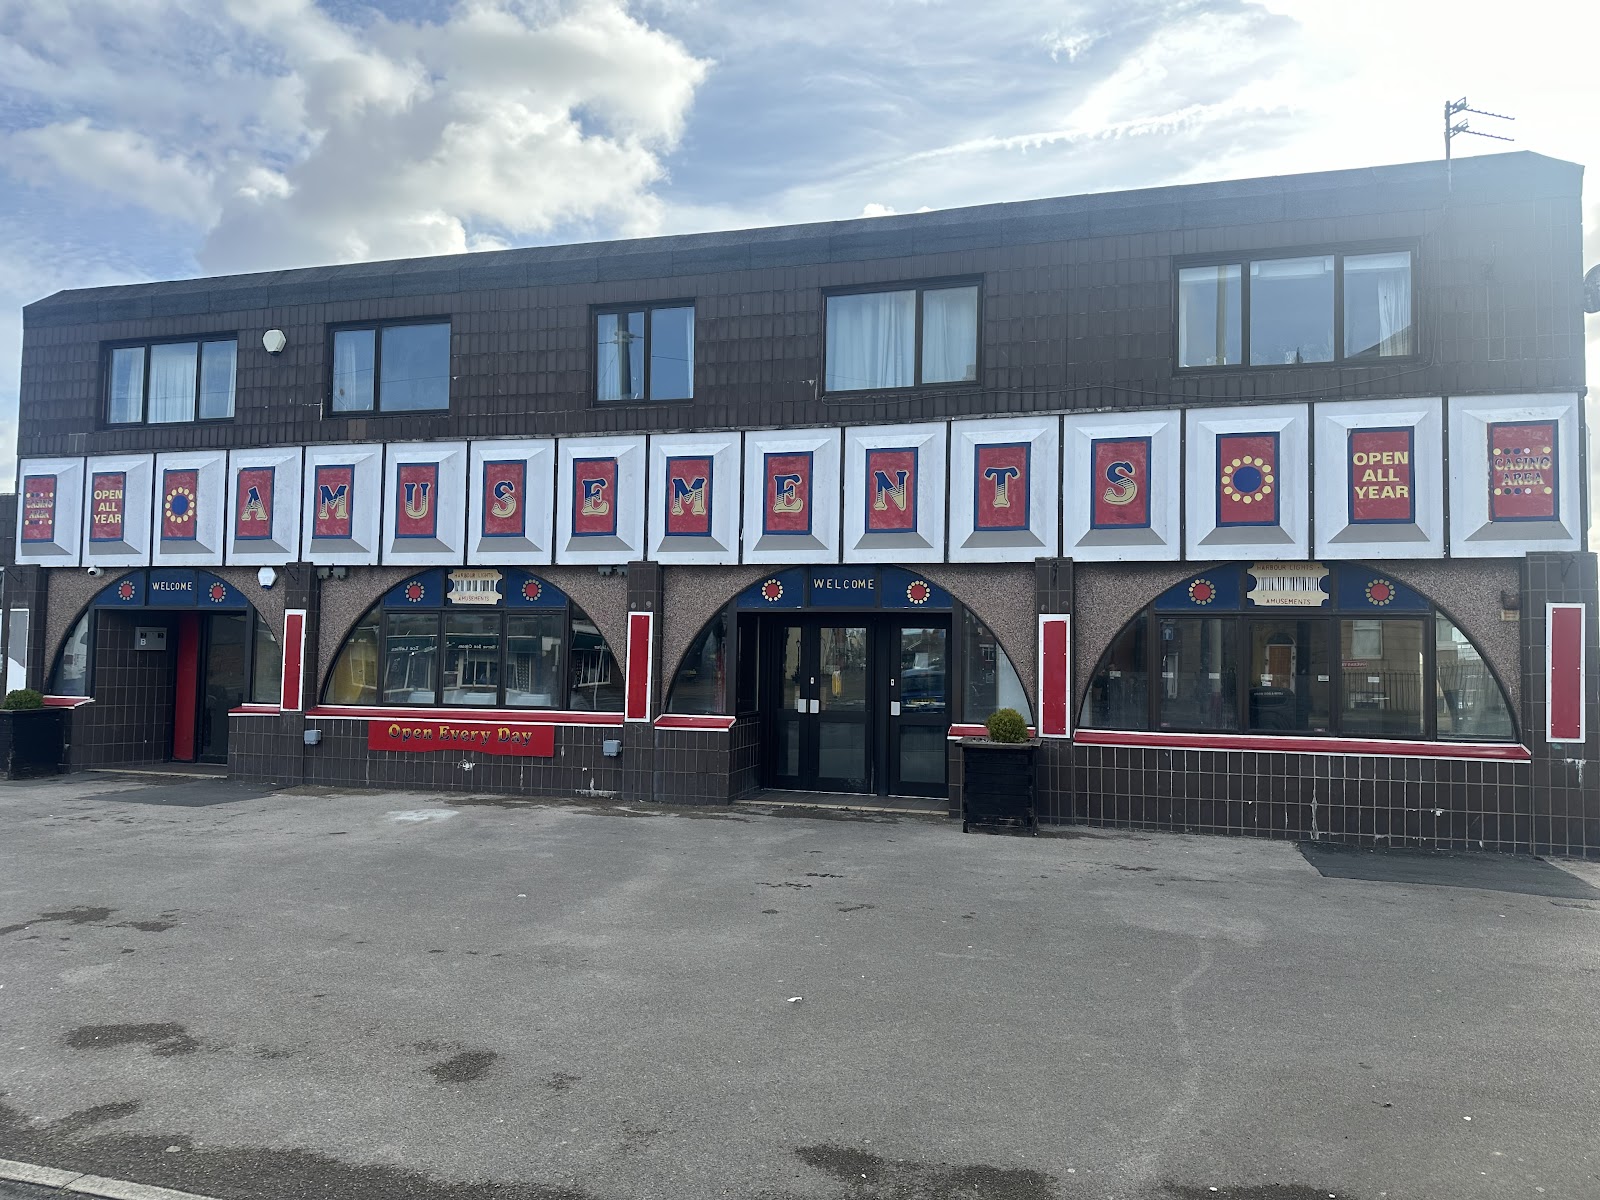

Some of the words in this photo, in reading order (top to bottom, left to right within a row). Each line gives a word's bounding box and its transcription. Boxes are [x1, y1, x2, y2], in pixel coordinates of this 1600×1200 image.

[1353, 451, 1409, 466] OPEN
[1494, 456, 1552, 471] CASINO
[1362, 468, 1399, 482] ALL
[1501, 472, 1545, 486] AREA
[94, 490, 123, 500] OPEN
[1354, 485, 1409, 499] YEAR
[98, 502, 117, 511] ALL
[94, 514, 121, 523] YEAR
[152, 581, 193, 591] WELCOME
[813, 578, 875, 590] WELCOME
[388, 723, 433, 742] Open
[438, 725, 492, 745] Every
[497, 727, 533, 746] Day
